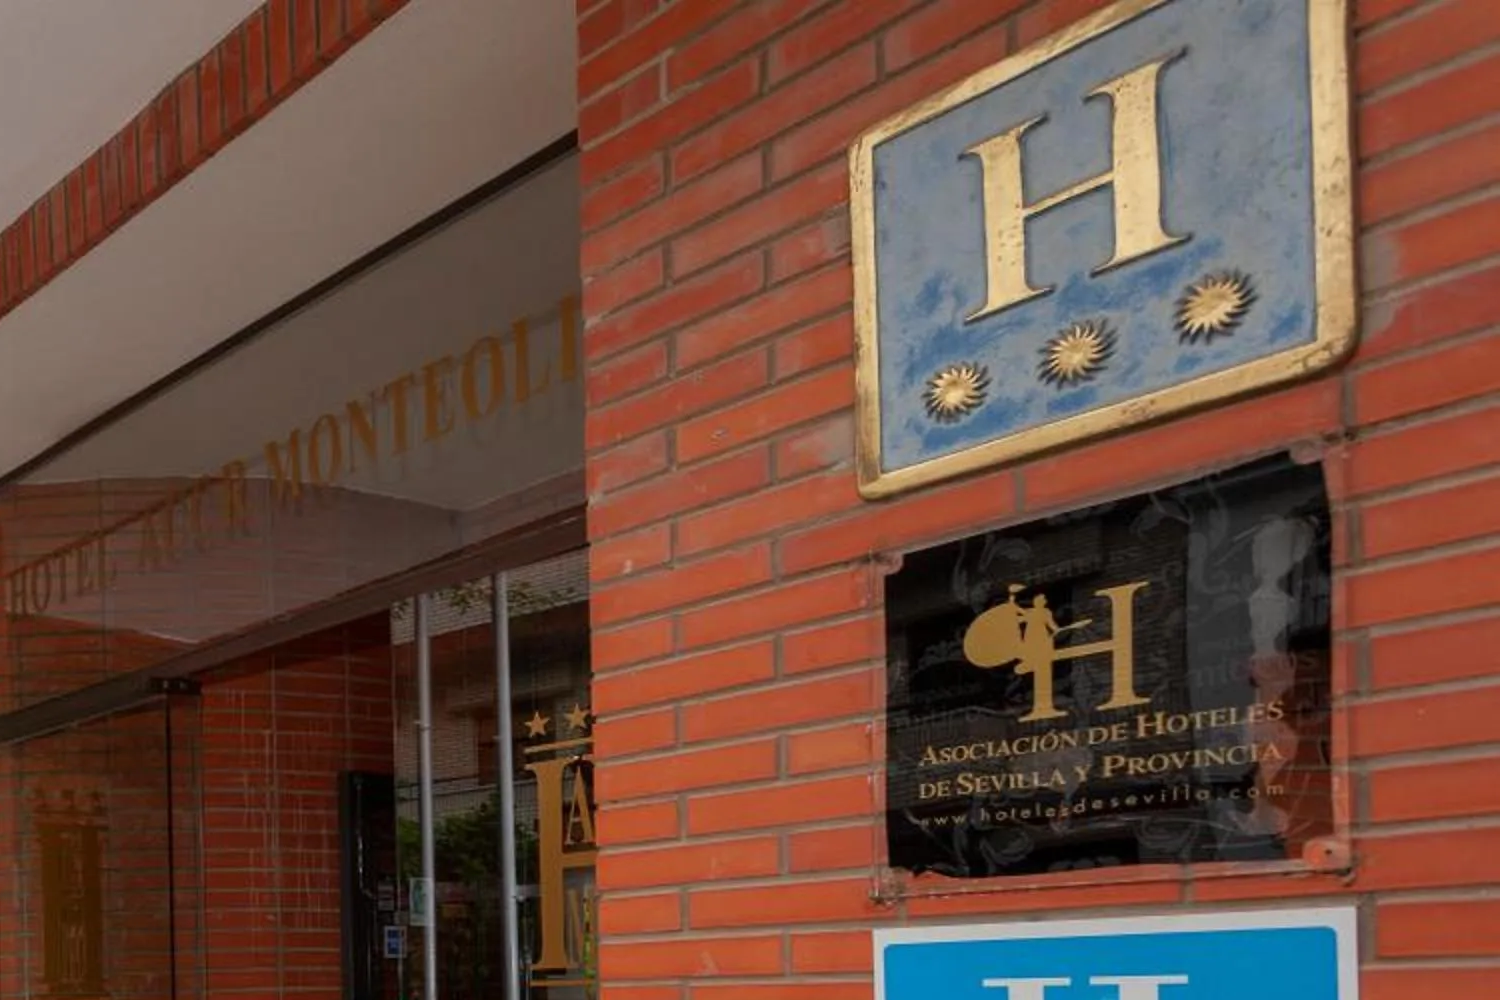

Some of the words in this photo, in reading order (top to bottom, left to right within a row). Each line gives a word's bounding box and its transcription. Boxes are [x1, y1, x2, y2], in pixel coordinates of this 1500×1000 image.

[957, 45, 1192, 326] H
[918, 730, 1078, 768] ASOCIACIÓN
[1088, 721, 1129, 746] DE
[1136, 699, 1286, 740] HOTELES
[918, 780, 951, 800] DE
[956, 770, 1067, 797] SEVILLA
[1074, 763, 1092, 784] Y
[1102, 741, 1285, 780] PROVINCIA
